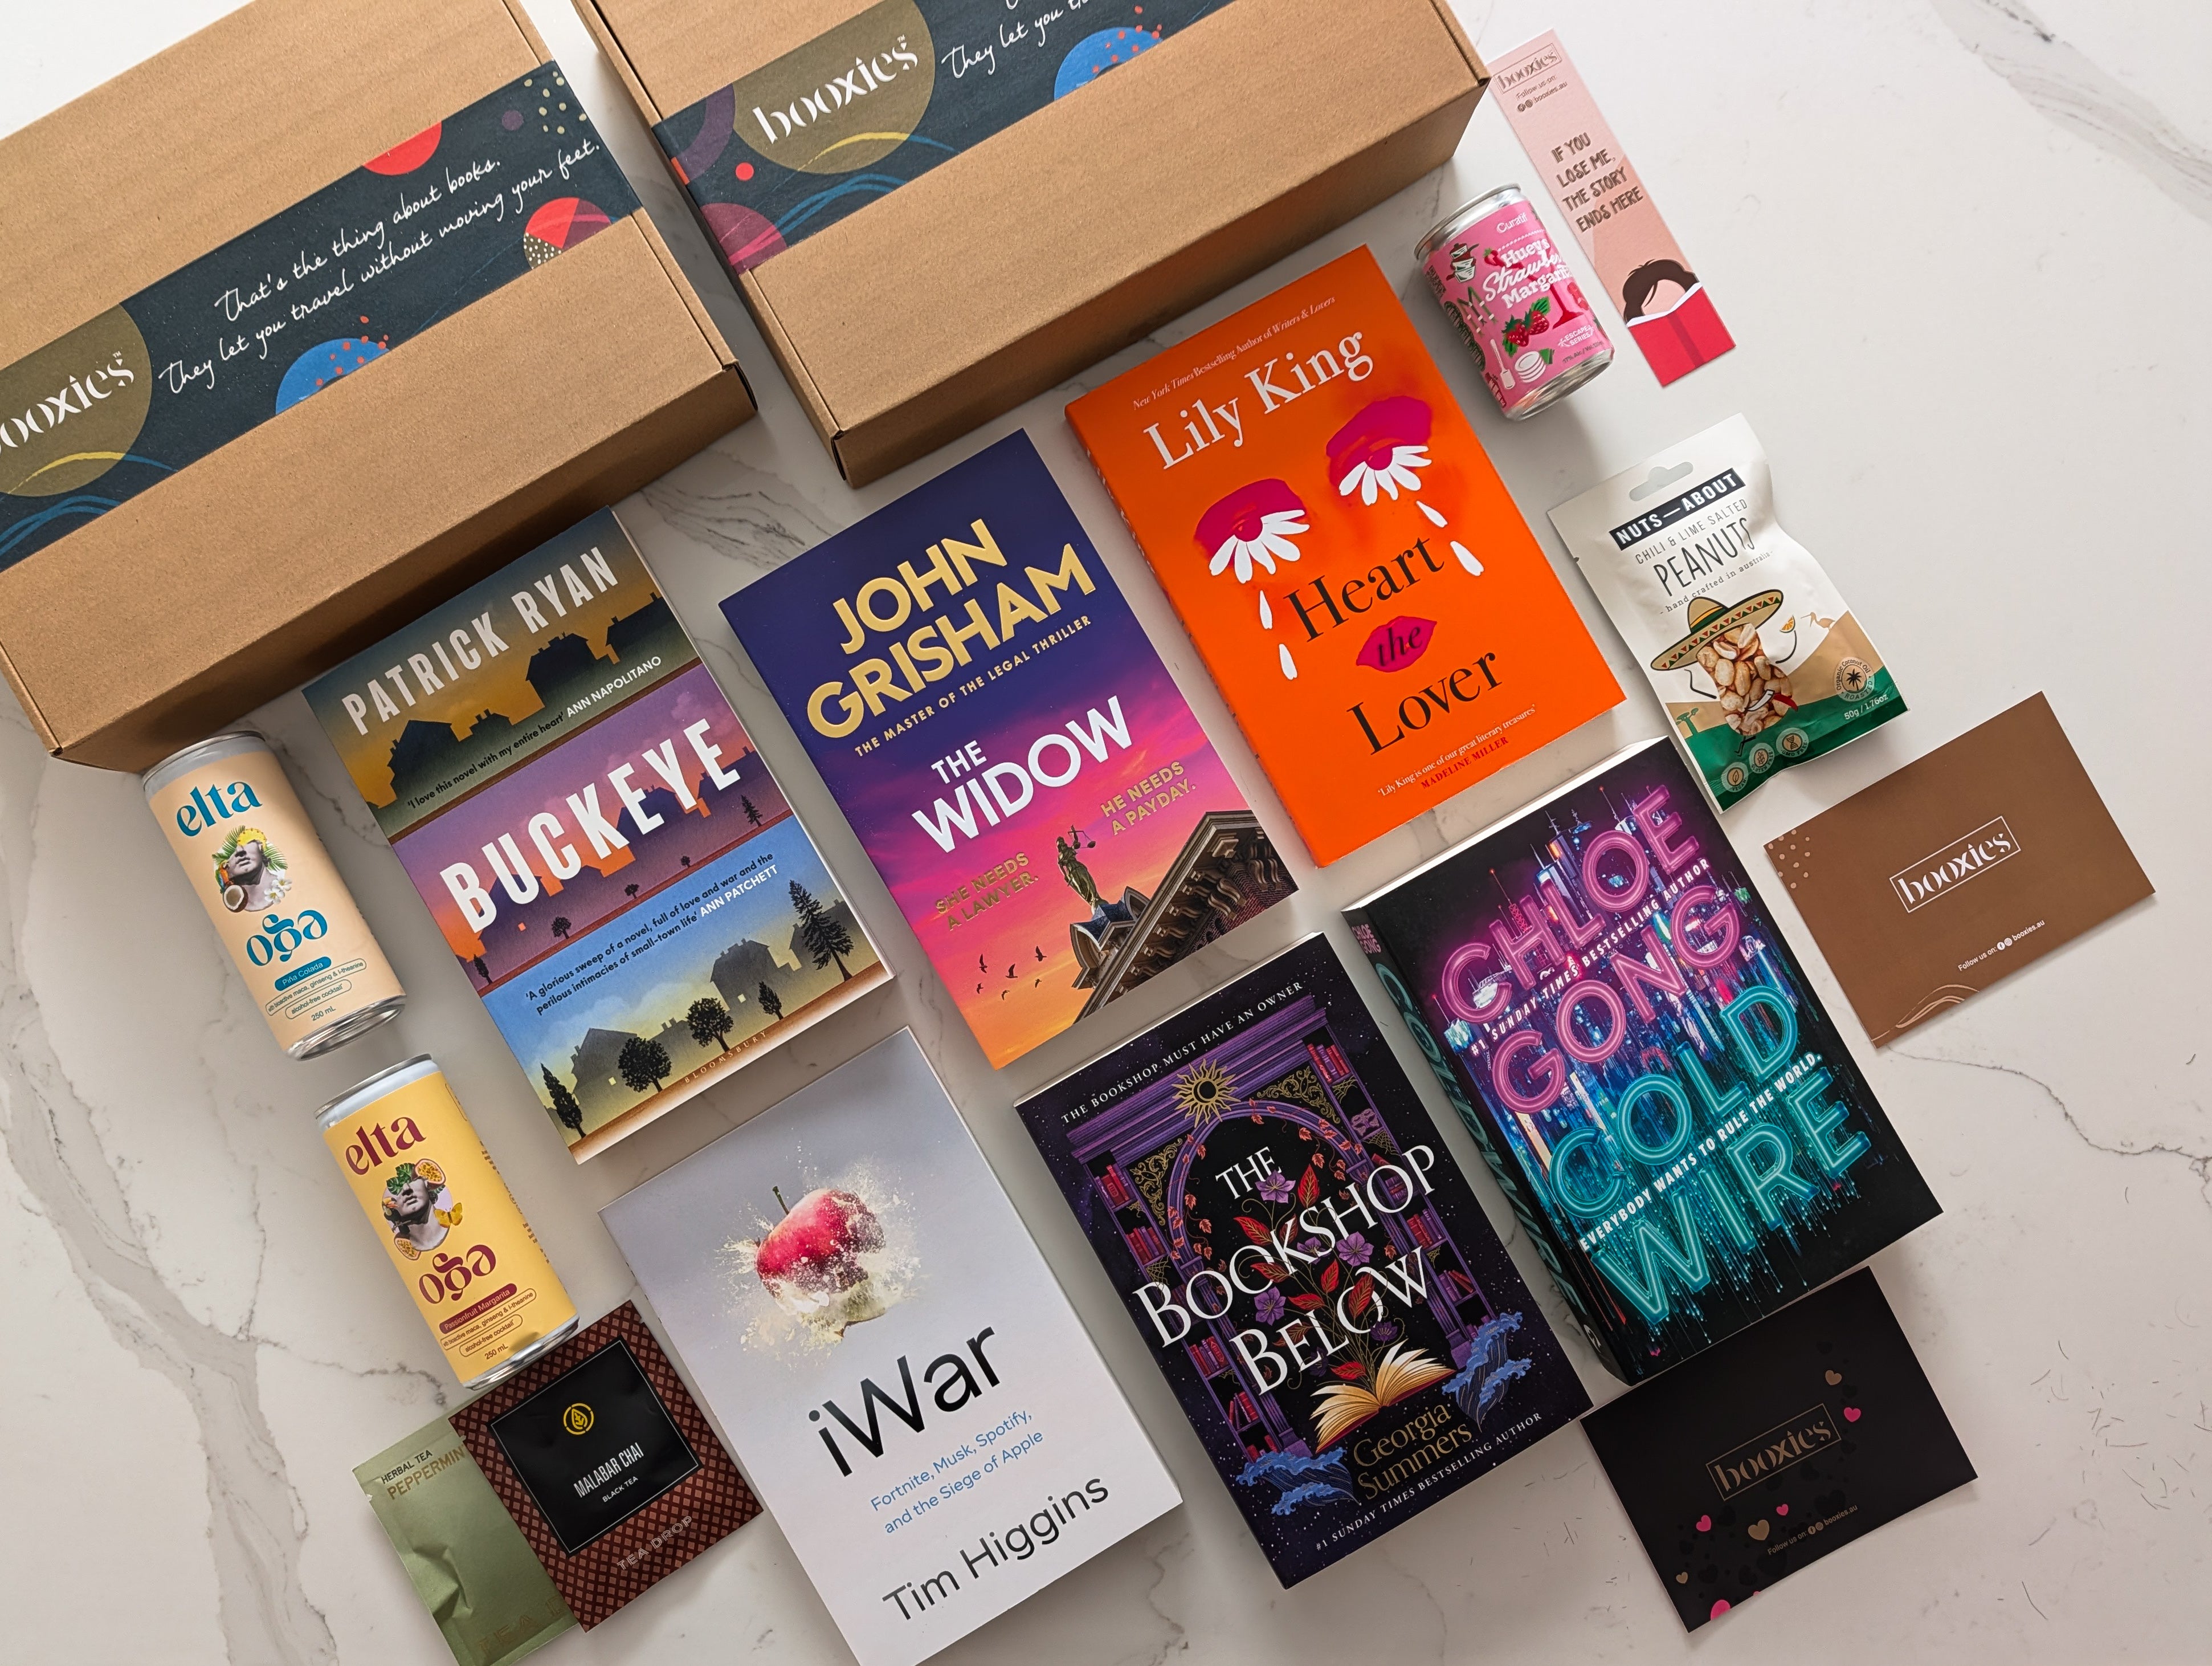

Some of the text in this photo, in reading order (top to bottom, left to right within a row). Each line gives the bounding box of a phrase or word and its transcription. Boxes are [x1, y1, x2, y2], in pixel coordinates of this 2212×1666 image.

[752, 41, 918, 145] booxies
[1497, 50, 1557, 89] booxies
[1551, 132, 1591, 164] IF YOU
[1556, 148, 1616, 188] LOSE ME,
[1496, 212, 1528, 234] Curatif
[1561, 166, 1627, 212] THE STORY
[1575, 186, 1643, 233] ENDS HERE
[158, 139, 599, 394] They let you travel without moving your feet.
[214, 159, 500, 321] That's the thing about books.
[1133, 296, 1335, 410] New York Times Bestselling Author of Writers & Lovers
[1565, 325, 1589, 341] ESCAPE
[1570, 332, 1590, 346] SERIES
[0, 357, 134, 449] ooxies
[1143, 397, 1243, 470] Lily
[1244, 332, 1373, 414] King
[1635, 499, 1748, 564] CHILI & LIME SALTED
[1653, 517, 1755, 597] PEANUTS
[832, 518, 1007, 654] JOHN
[1283, 537, 1444, 642] Heart
[1665, 595, 1689, 612] hand
[1692, 576, 1724, 598] crafted
[1738, 551, 1770, 575] australia
[341, 547, 618, 735] PATRICK RYAN
[807, 543, 1096, 737] GRISHAM
[1377, 626, 1423, 667] the
[1862, 665, 1871, 674] Oil
[855, 616, 1091, 757] THE MASTER OF THE LEGAL THRILLER
[1346, 652, 1503, 756] Lover
[1844, 681, 1873, 700] ROASTED
[1844, 709, 1859, 720] 50g
[1864, 694, 1889, 710] 1.76oz
[414, 791, 436, 806] love
[435, 781, 453, 794] this
[452, 763, 478, 784] novel
[478, 753, 499, 769] with
[498, 746, 512, 757] my
[513, 731, 539, 748] entire
[567, 696, 591, 718] ANN
[590, 656, 662, 702] NAPOLITANO
[930, 740, 987, 785] THE
[1421, 736, 1509, 789] MADELINE MILLER
[911, 695, 1132, 853] WIDOW
[1101, 761, 1185, 818] HE NEEDS
[1112, 779, 1196, 836] A PAYDAY.
[177, 781, 263, 837] elta
[439, 718, 741, 934] BUCKEYE
[936, 853, 1030, 916] SHE NEEDS
[947, 872, 1039, 931] A LAWYER.
[1897, 833, 2011, 904] booxies
[1442, 785, 1699, 1024] CHLOE
[282, 962, 324, 987] Piña Colada
[1471, 858, 1709, 1056] #1 SUNDAY TIMES BESTSELLING AUTHOR
[1492, 885, 1740, 1114] GONG
[684, 1029, 769, 1083] BLOOMSBURY
[1062, 981, 1303, 1124] THE BOOKSHOP MUST HAVE AN OWNER
[1548, 985, 1798, 1217] COLD
[345, 1116, 427, 1175] elta
[1215, 1146, 1282, 1200] THE
[1580, 1053, 1821, 1252] EVERYBODY WANTS TO RULE THE WORLD.
[1591, 1066, 1872, 1325] WIRE
[1132, 1144, 1436, 1348] BOOKSHOP
[444, 1289, 511, 1330] Passionfruit Margarita
[1230, 1248, 1429, 1396] BELOW
[809, 1326, 1001, 1477] iWar
[1353, 1404, 1451, 1467] Georgia
[381, 1449, 433, 1485] HERBAL TEA
[386, 1444, 466, 1500] PEPPERMIN
[573, 1443, 644, 1498] MALABAR CHAI
[602, 1476, 639, 1502] BLACK TEA
[870, 1408, 1033, 1512] Fortnite, Musk, Spotify,
[885, 1431, 1044, 1533] and the Siege of Apple
[1357, 1424, 1472, 1500] Summers
[1714, 1421, 1831, 1492] booxies
[616, 1515, 693, 1570] TEA DROP
[882, 1478, 1109, 1620] Tim Higgins
